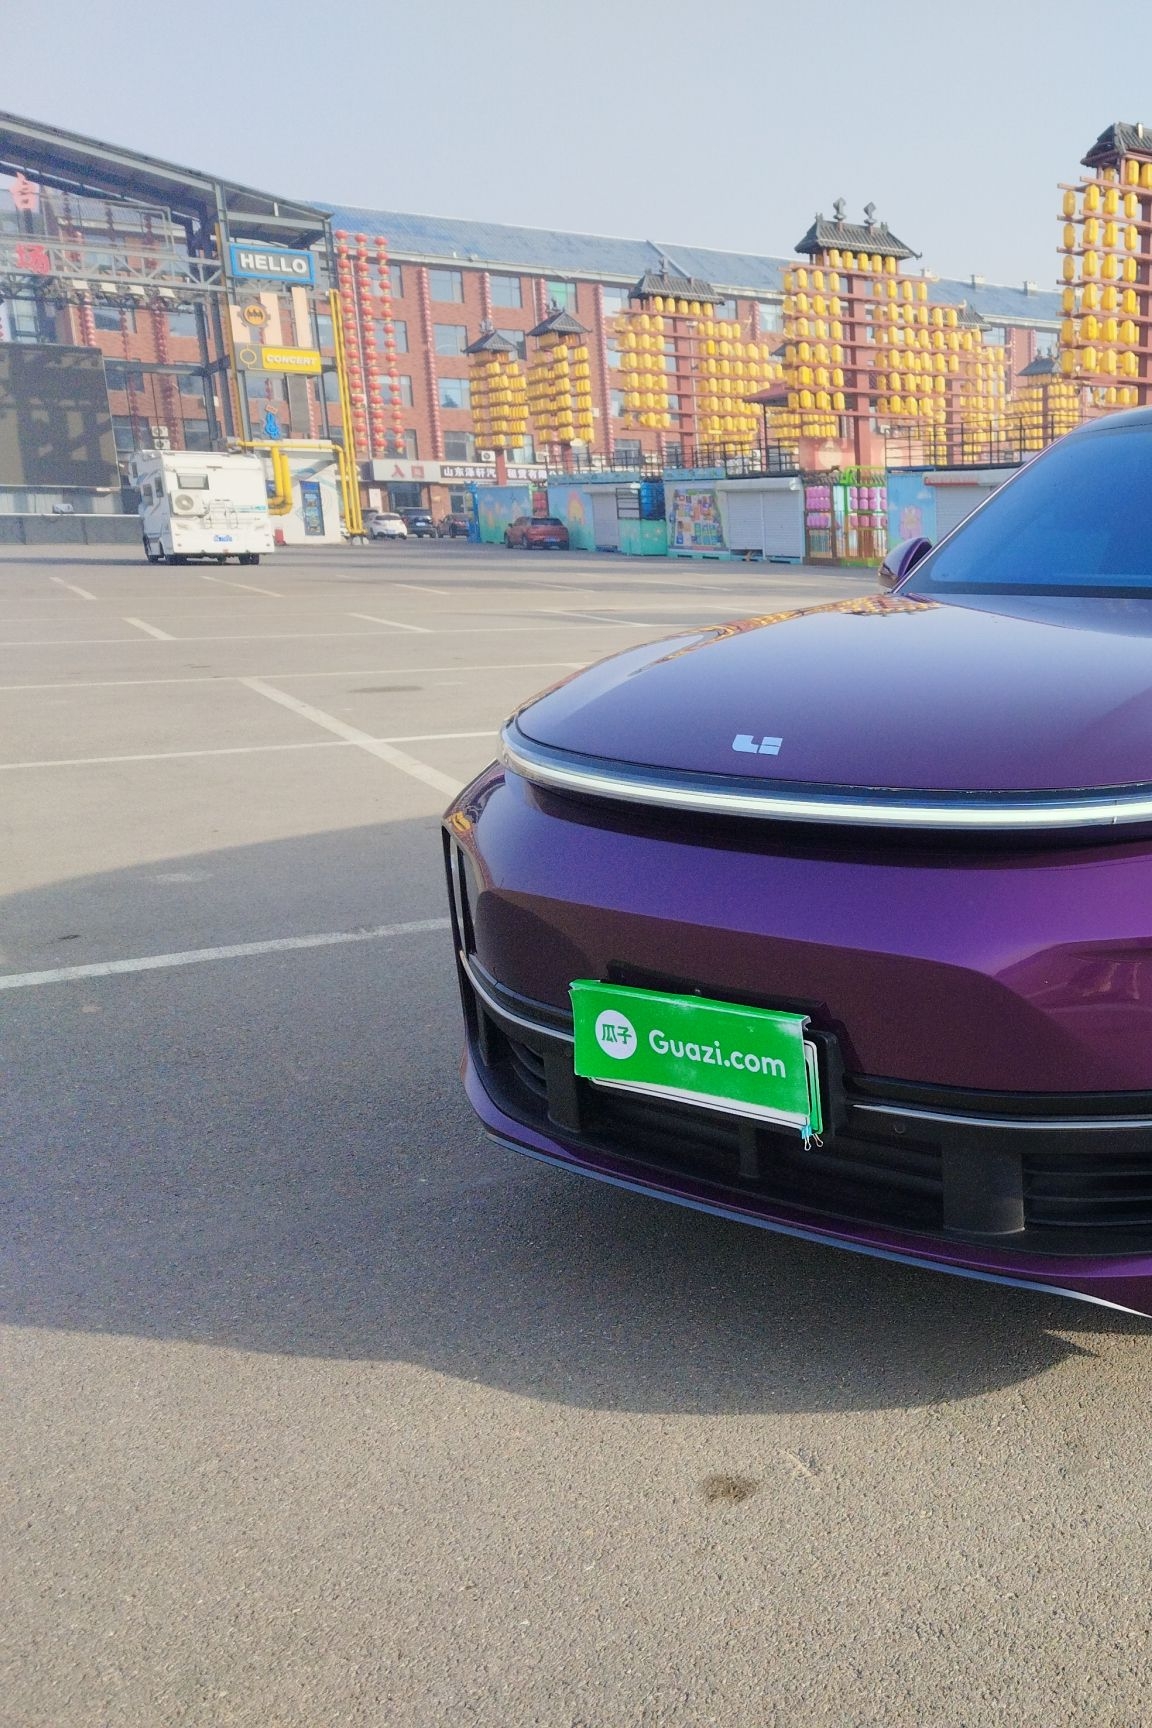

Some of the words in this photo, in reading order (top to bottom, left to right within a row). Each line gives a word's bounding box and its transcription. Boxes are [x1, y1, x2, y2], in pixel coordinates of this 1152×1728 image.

[240, 253, 307, 274] HELLO
[266, 353, 315, 366] CONCERT
[392, 464, 425, 479] 入口
[602, 1024, 632, 1044] 瓜子
[649, 1029, 787, 1078] Guazi.com
